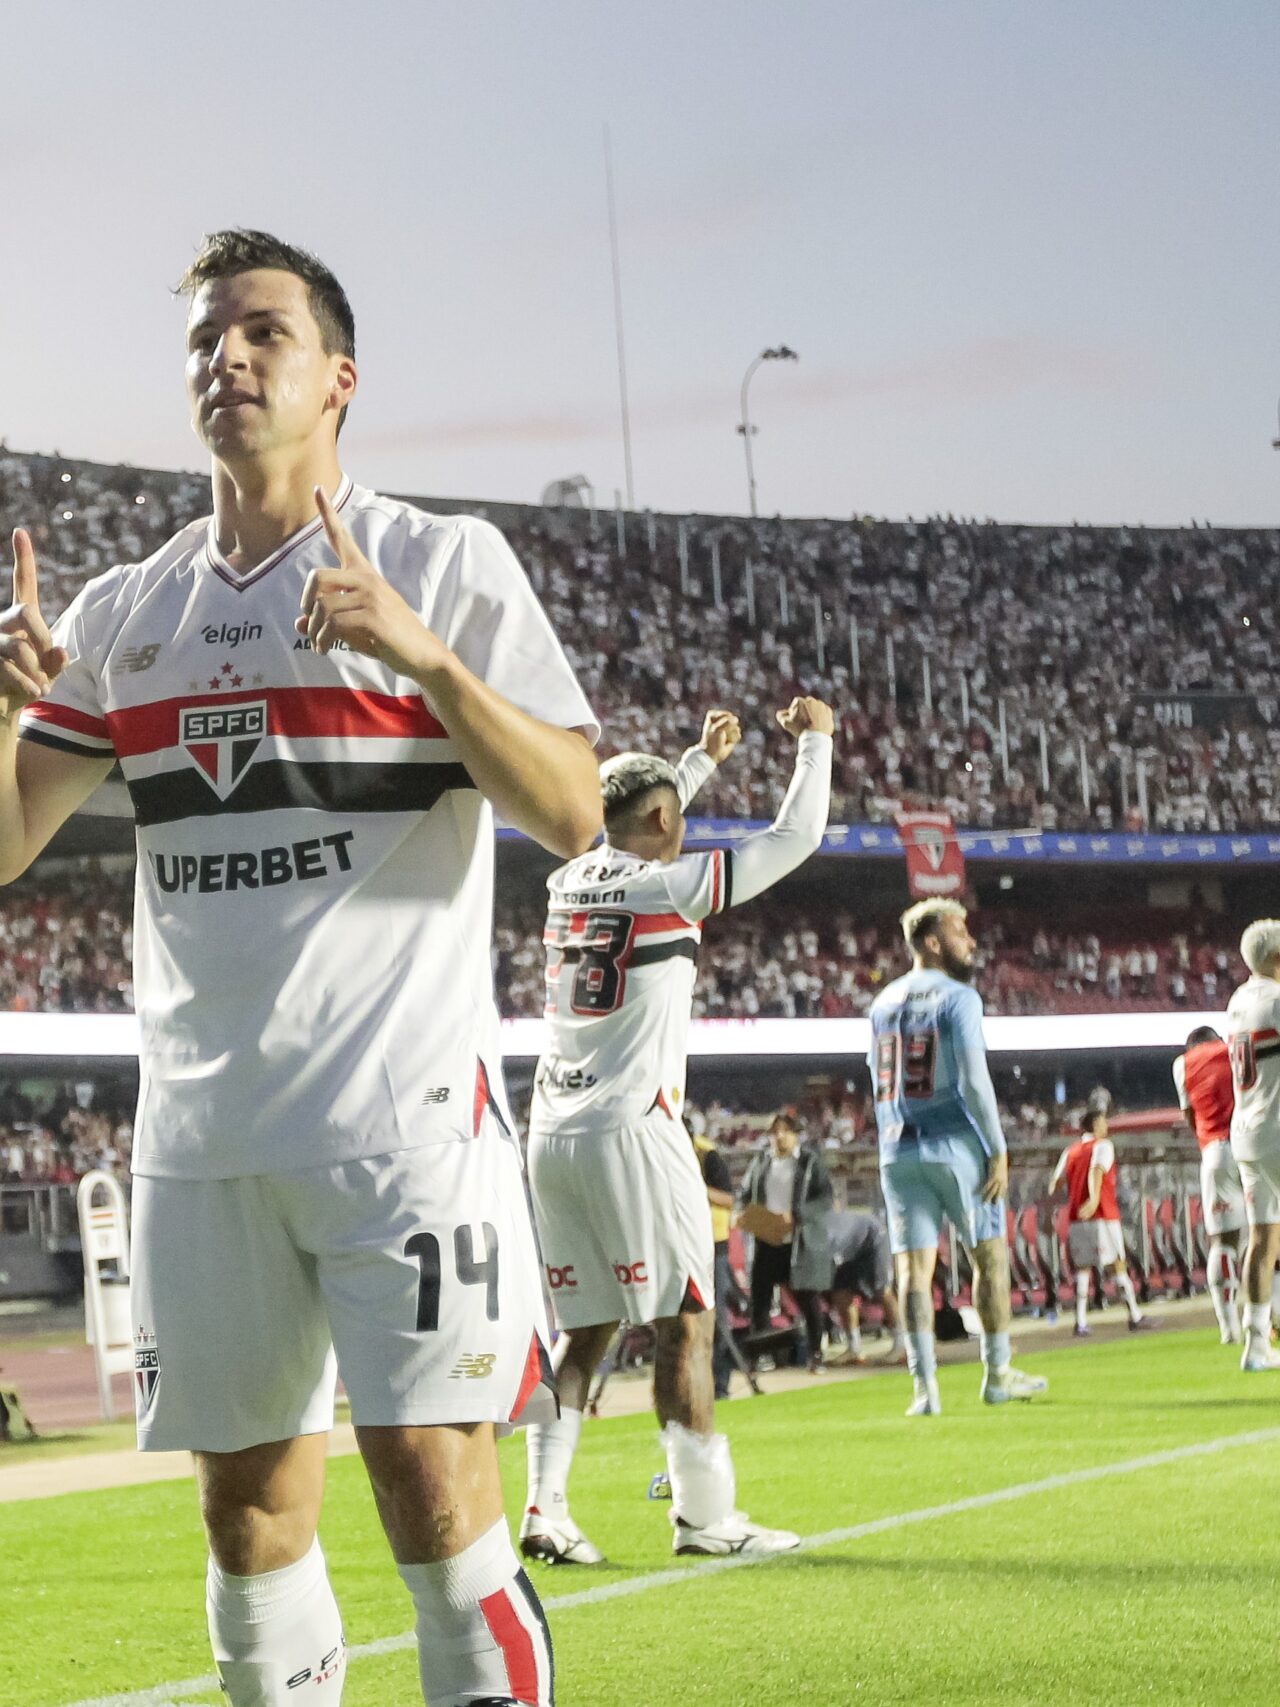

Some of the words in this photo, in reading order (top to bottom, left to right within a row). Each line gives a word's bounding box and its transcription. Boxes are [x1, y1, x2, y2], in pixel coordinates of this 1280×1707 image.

[201, 620, 263, 649] elgin
[188, 710, 260, 737] SPFC
[148, 830, 355, 894] UPERBET
[403, 1221, 500, 1332] 14
